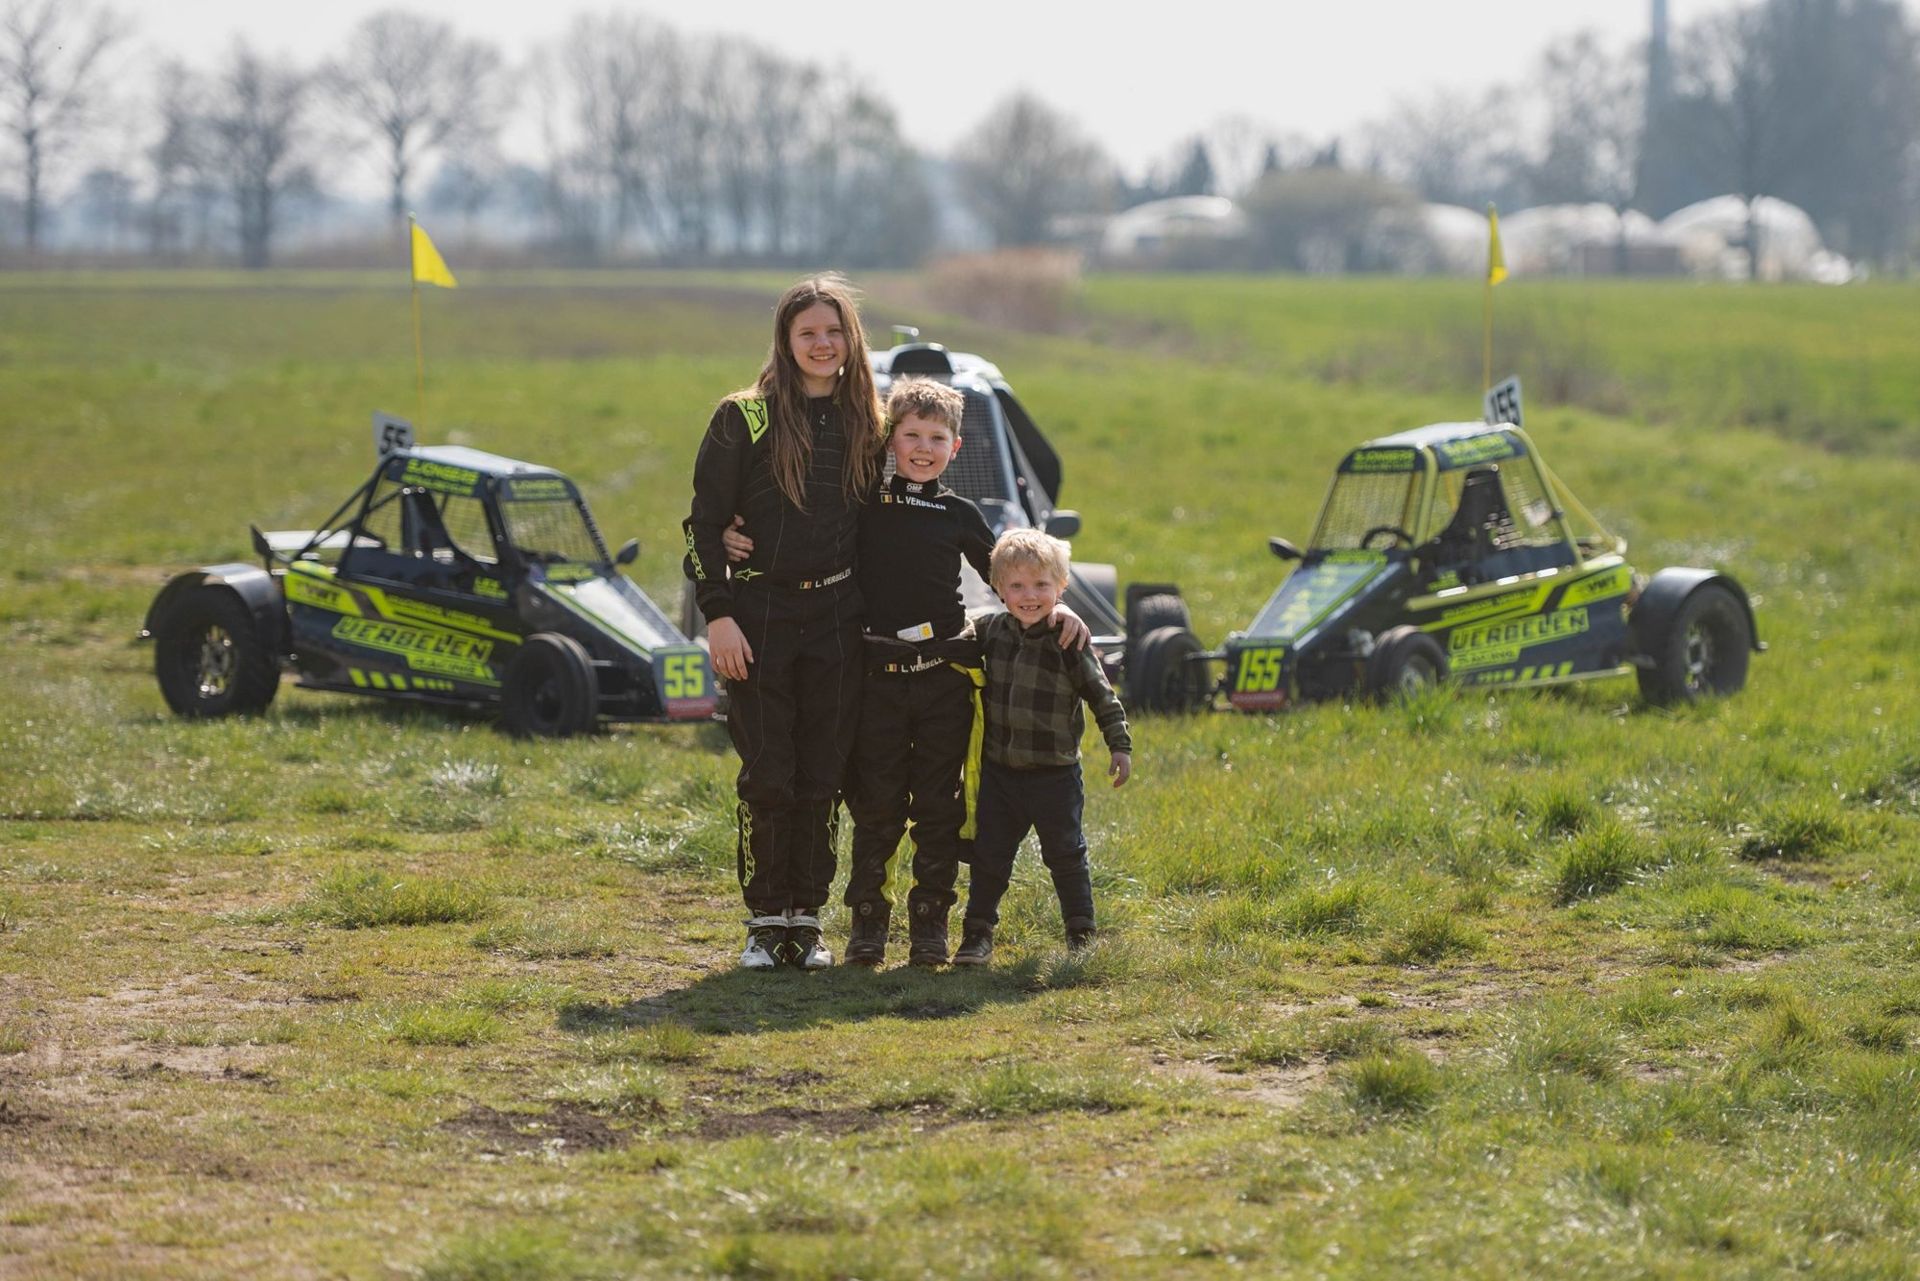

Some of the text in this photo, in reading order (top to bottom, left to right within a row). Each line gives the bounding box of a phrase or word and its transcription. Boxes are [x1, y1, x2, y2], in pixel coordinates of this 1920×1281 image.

[1489, 383, 1521, 427] 155
[380, 423, 407, 455] 55
[905, 495, 947, 511] VERBELEN
[663, 654, 705, 698] 55
[910, 657, 945, 673] VERBELE
[1236, 647, 1285, 692] 155
